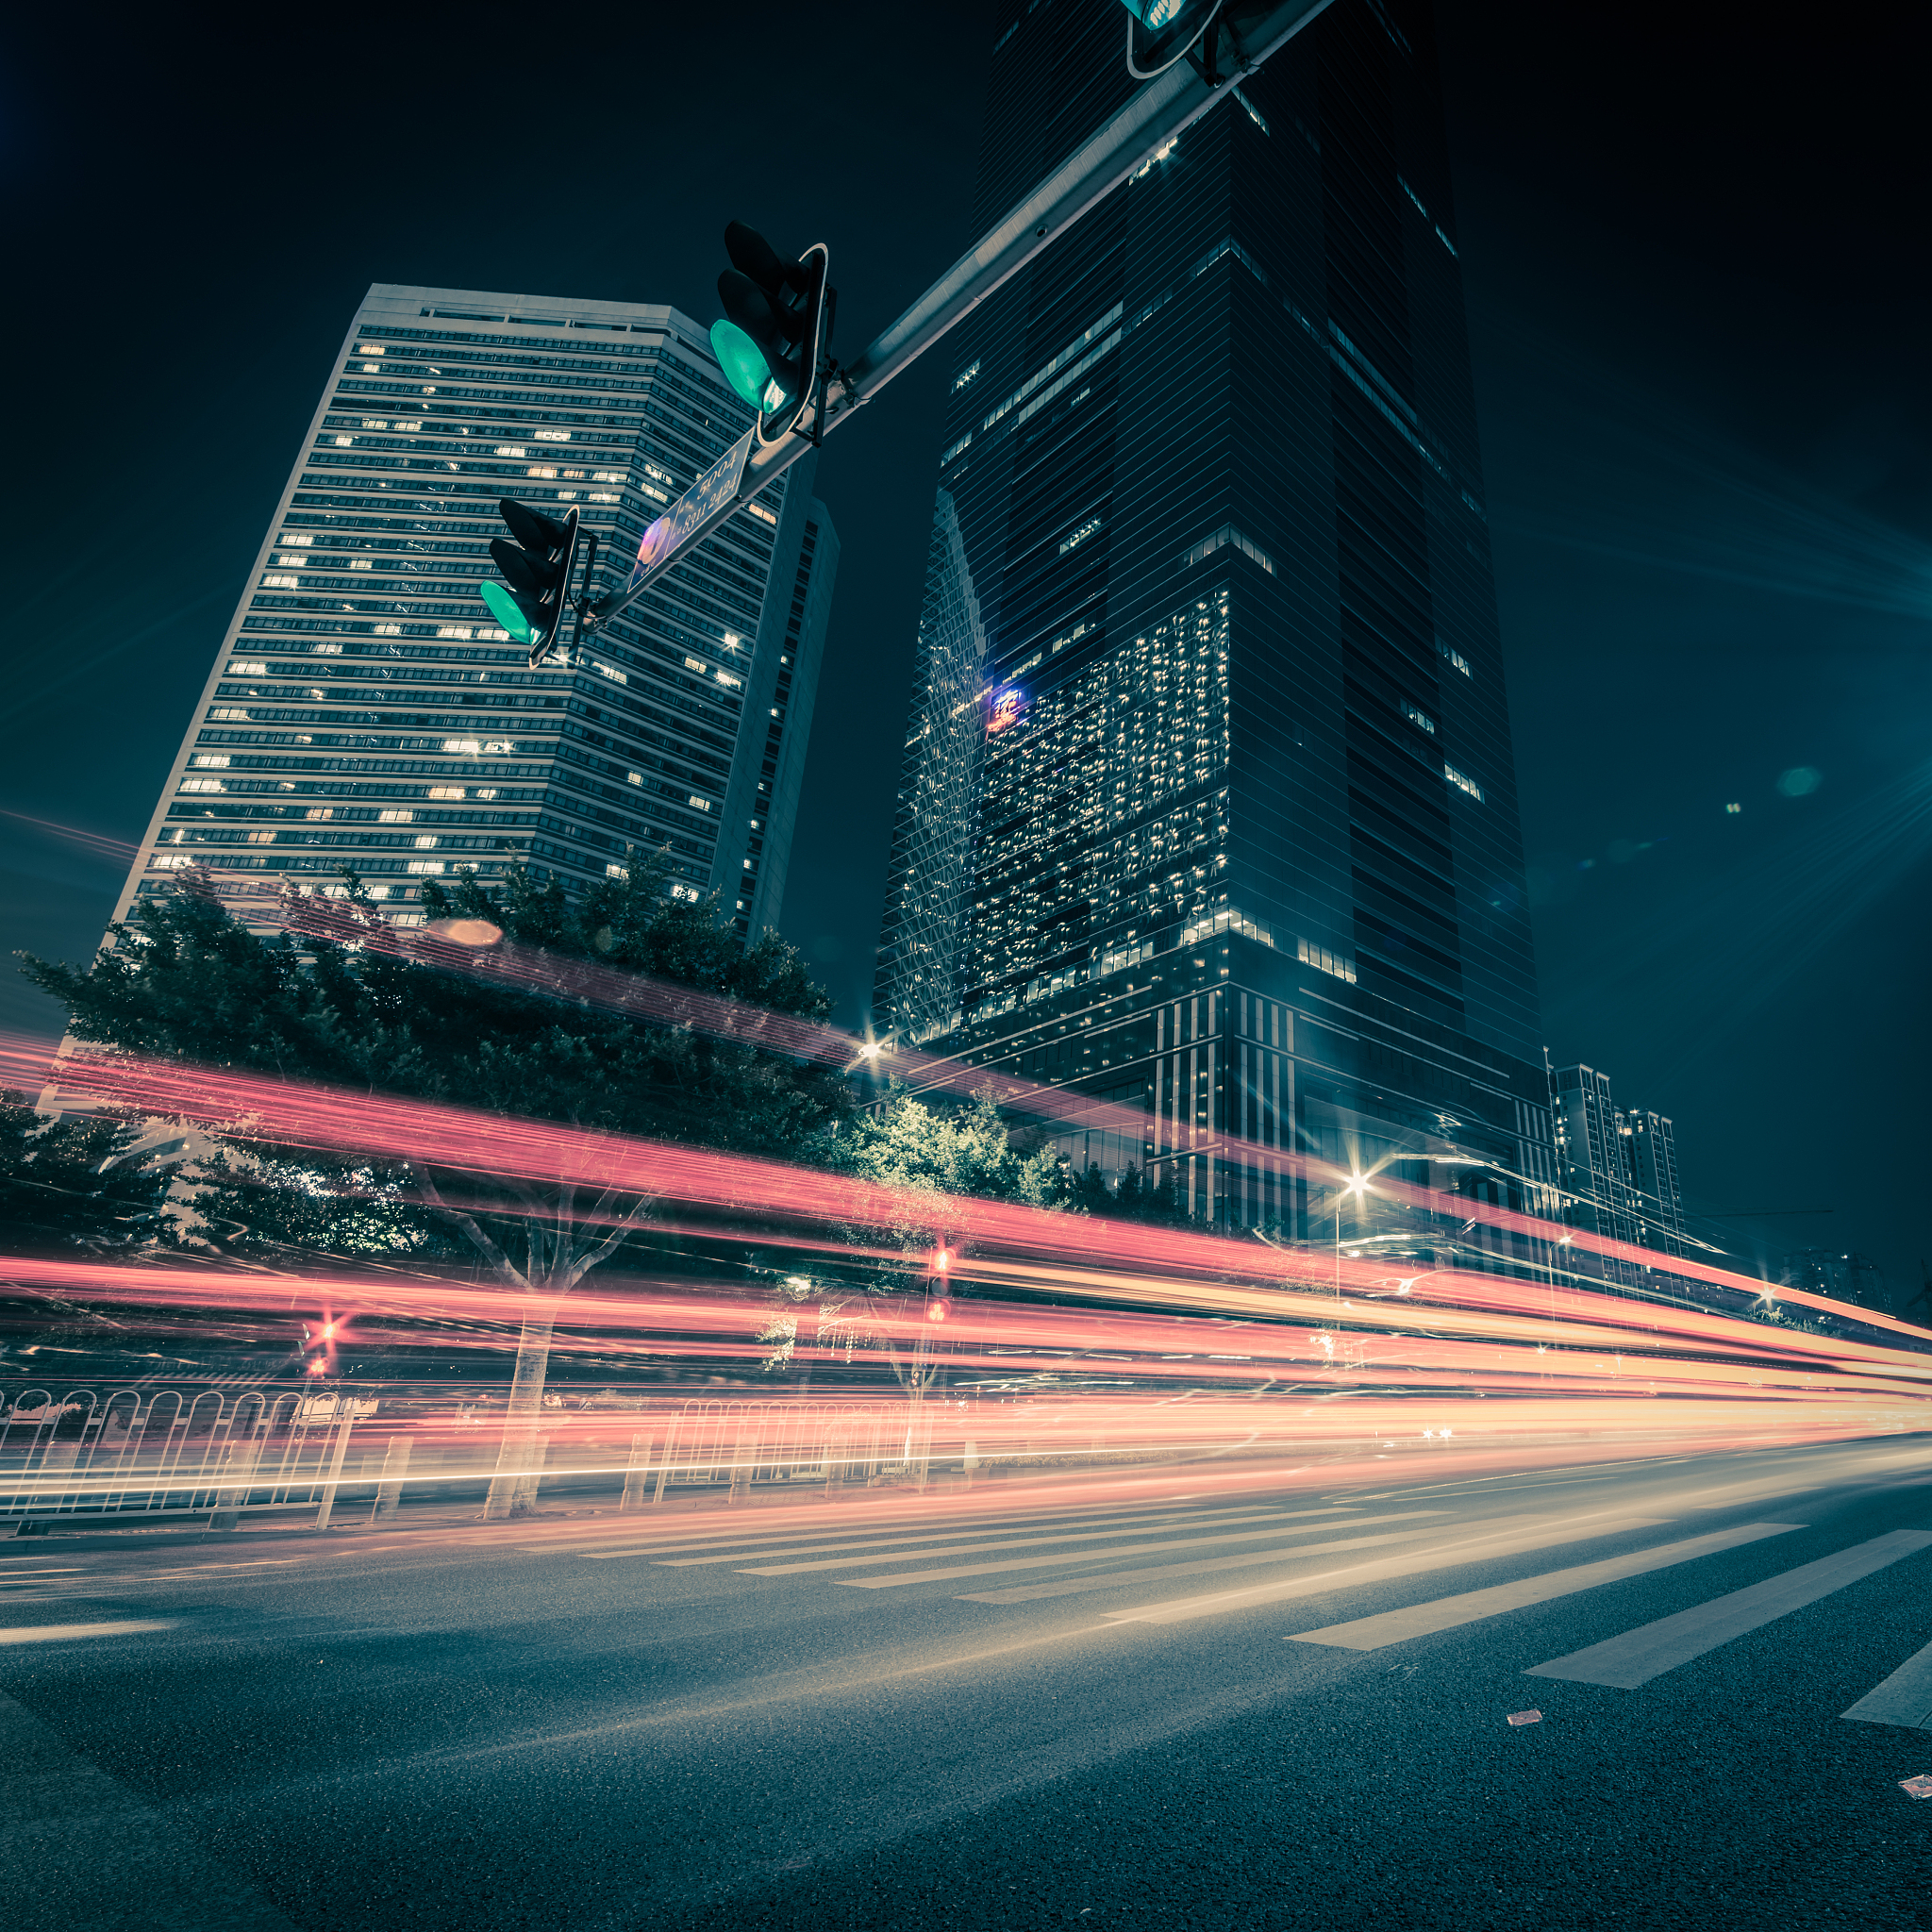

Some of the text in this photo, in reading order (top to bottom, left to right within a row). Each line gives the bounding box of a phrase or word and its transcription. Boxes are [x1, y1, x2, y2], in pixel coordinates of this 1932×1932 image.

[697, 451, 737, 500] 5004
[682, 502, 708, 534] 8311
[708, 473, 738, 509] 2424
